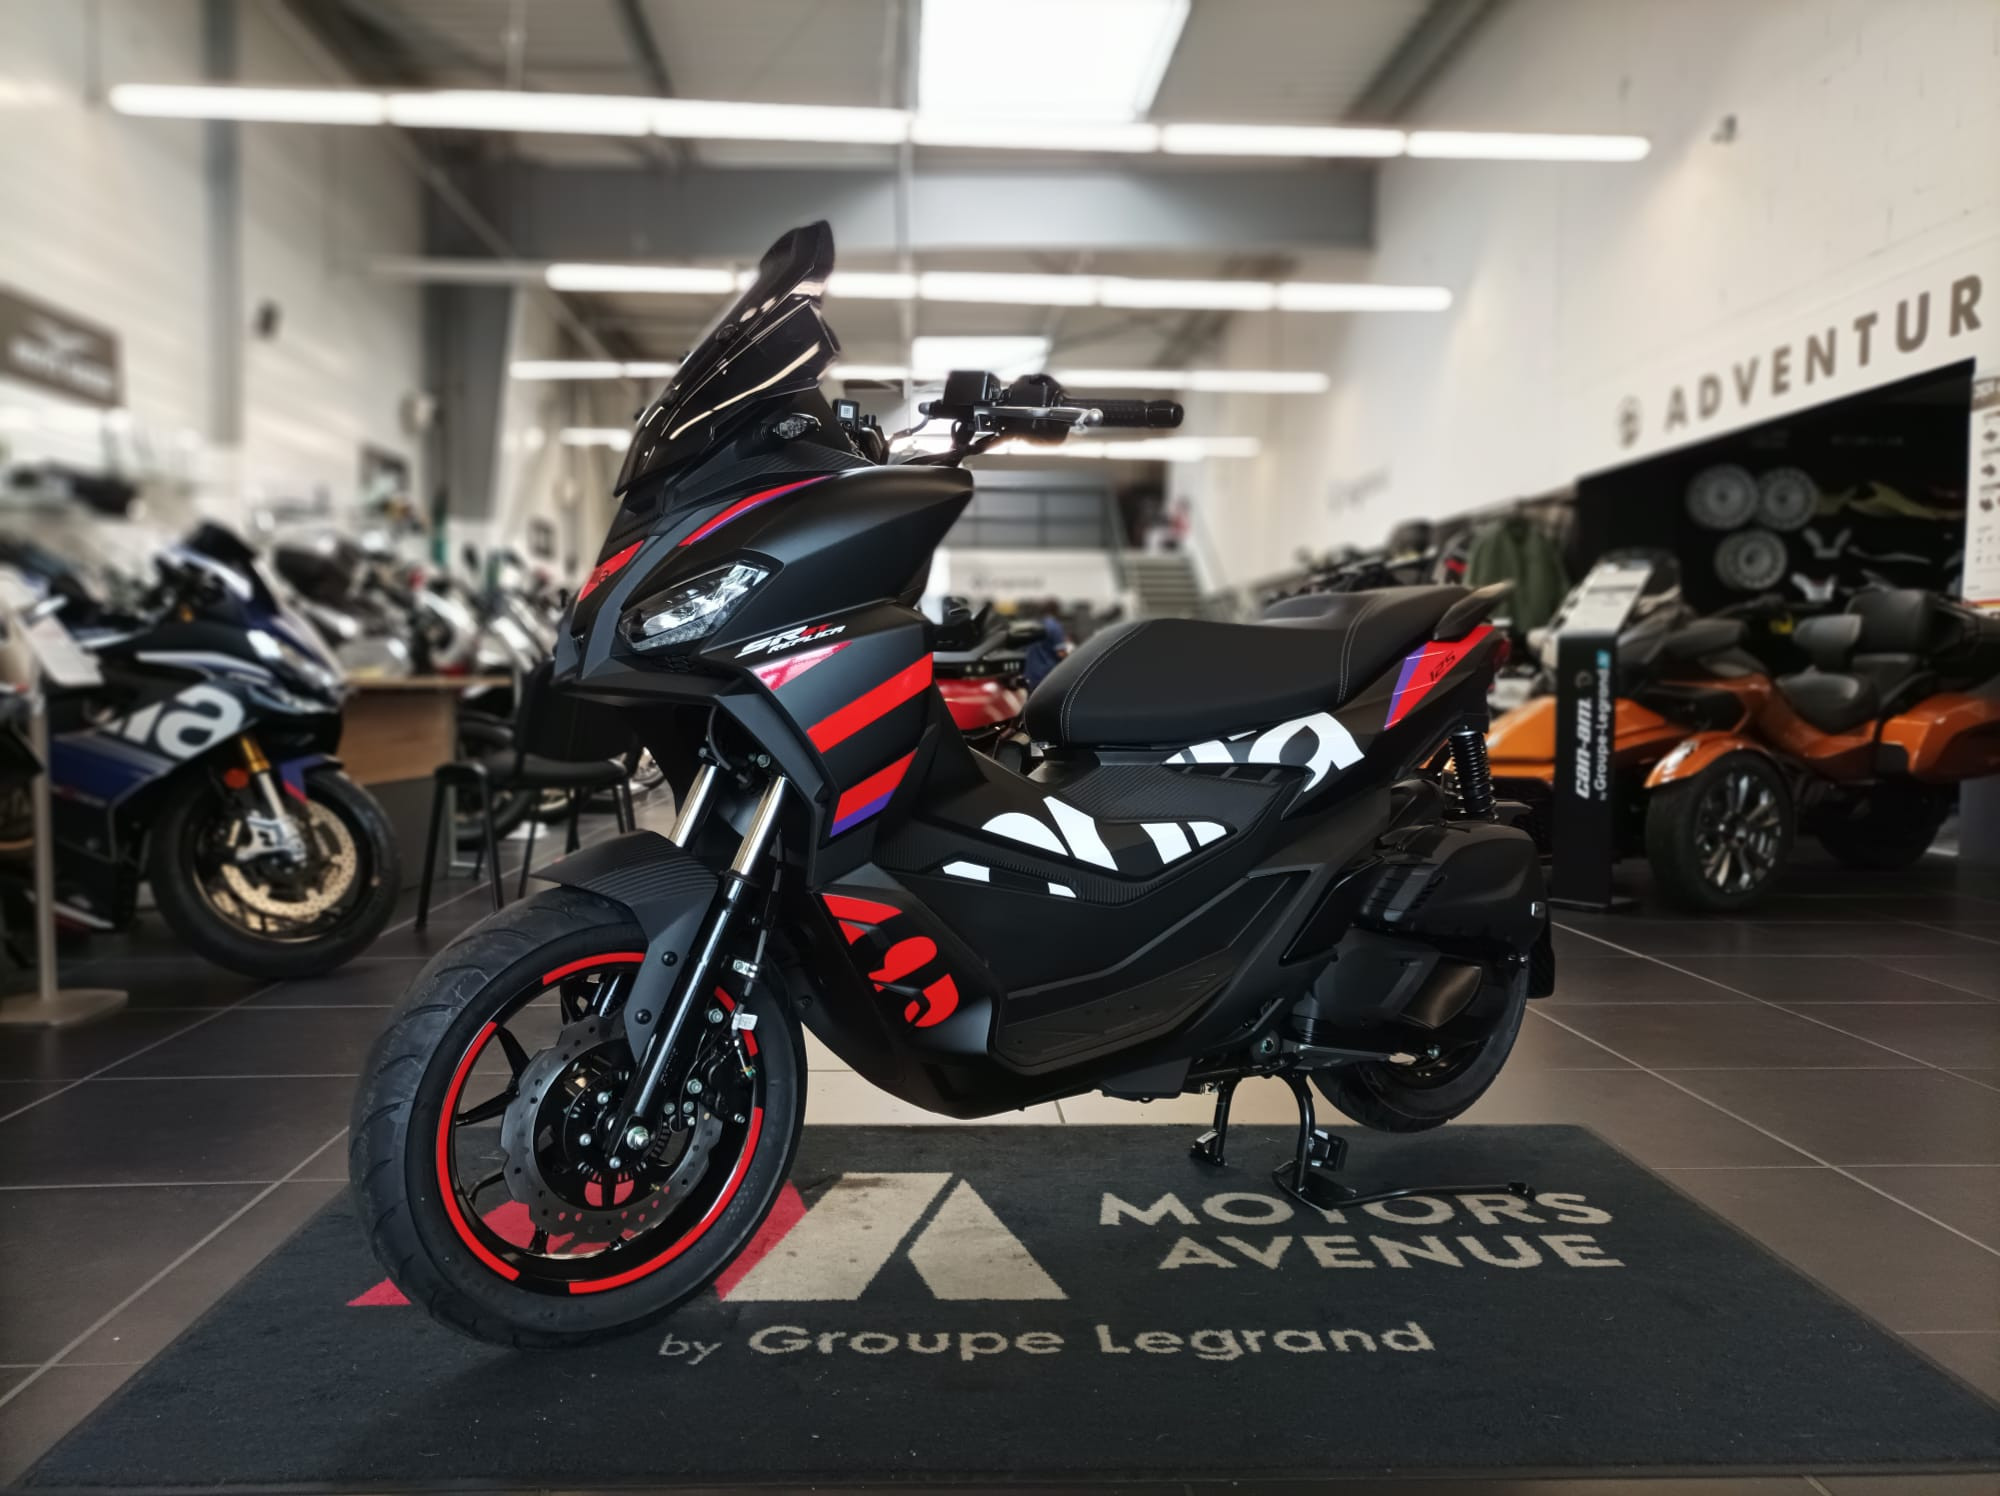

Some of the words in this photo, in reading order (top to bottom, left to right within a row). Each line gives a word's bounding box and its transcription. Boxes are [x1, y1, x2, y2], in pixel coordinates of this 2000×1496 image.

[1663, 274, 1983, 433] ADVENTUR
[1157, 1235, 1626, 1270] AVENUE
[658, 1333, 723, 1366] by
[748, 1325, 1065, 1361] Groupe
[1096, 1321, 1436, 1361] Legrand
